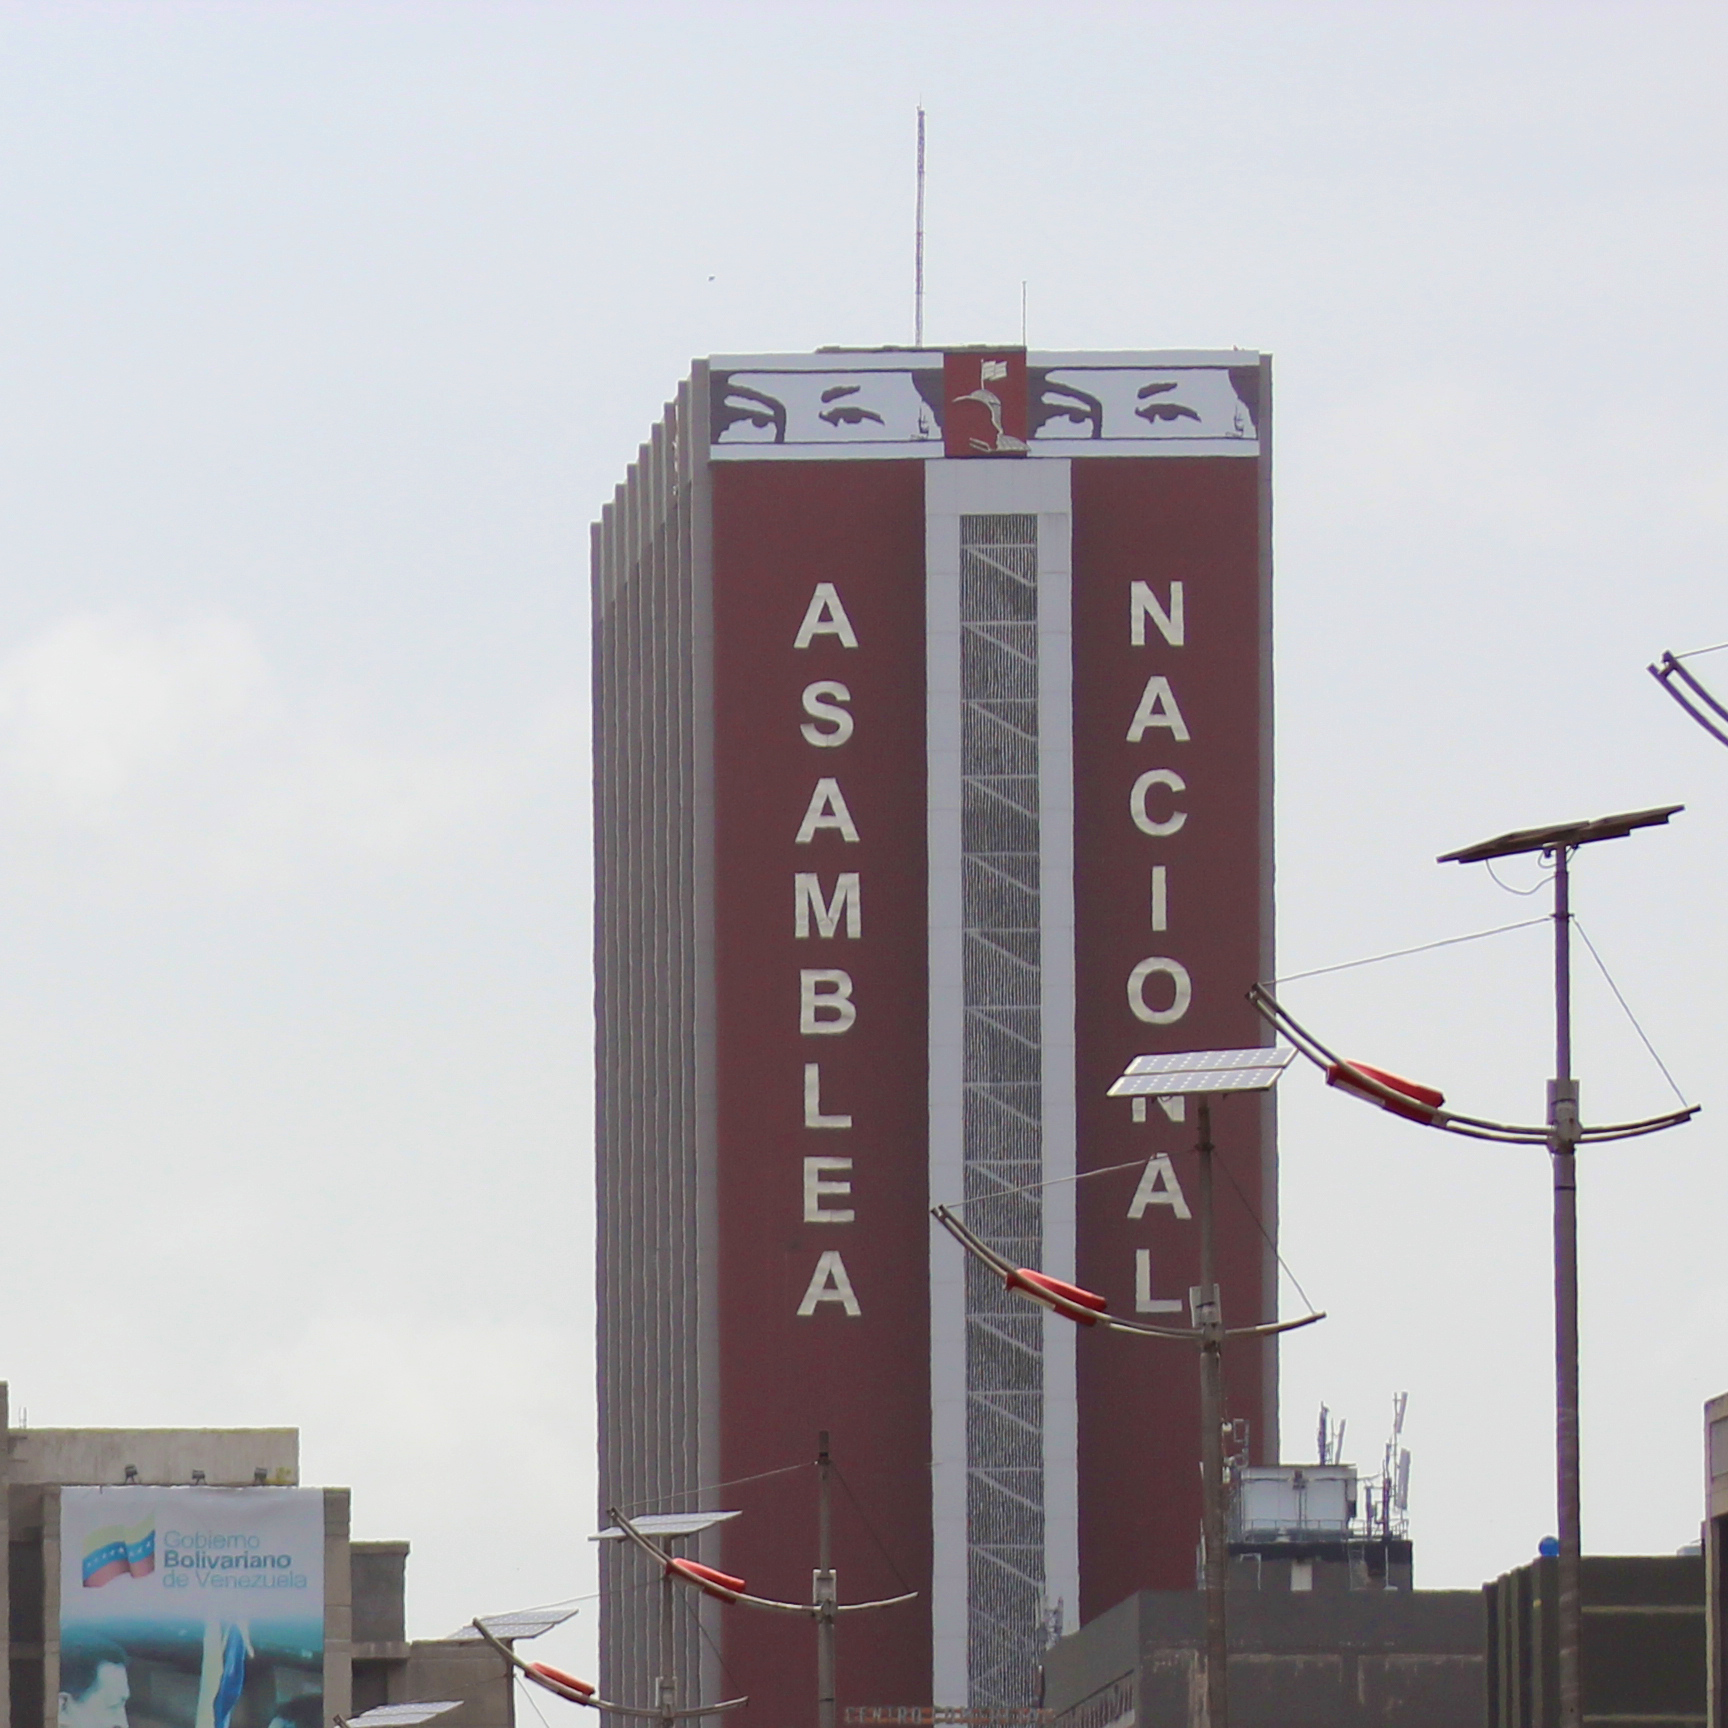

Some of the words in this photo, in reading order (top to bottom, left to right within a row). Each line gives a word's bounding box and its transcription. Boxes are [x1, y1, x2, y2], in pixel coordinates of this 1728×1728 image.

[792, 581, 863, 1318] ASAMBLEA
[163, 1530, 260, 1549] Gobierno
[164, 1550, 292, 1569] Bolivariano
[162, 1569, 189, 1588] de
[195, 1570, 308, 1588] Venezuela
[844, 1706, 922, 1725] CENTRO
